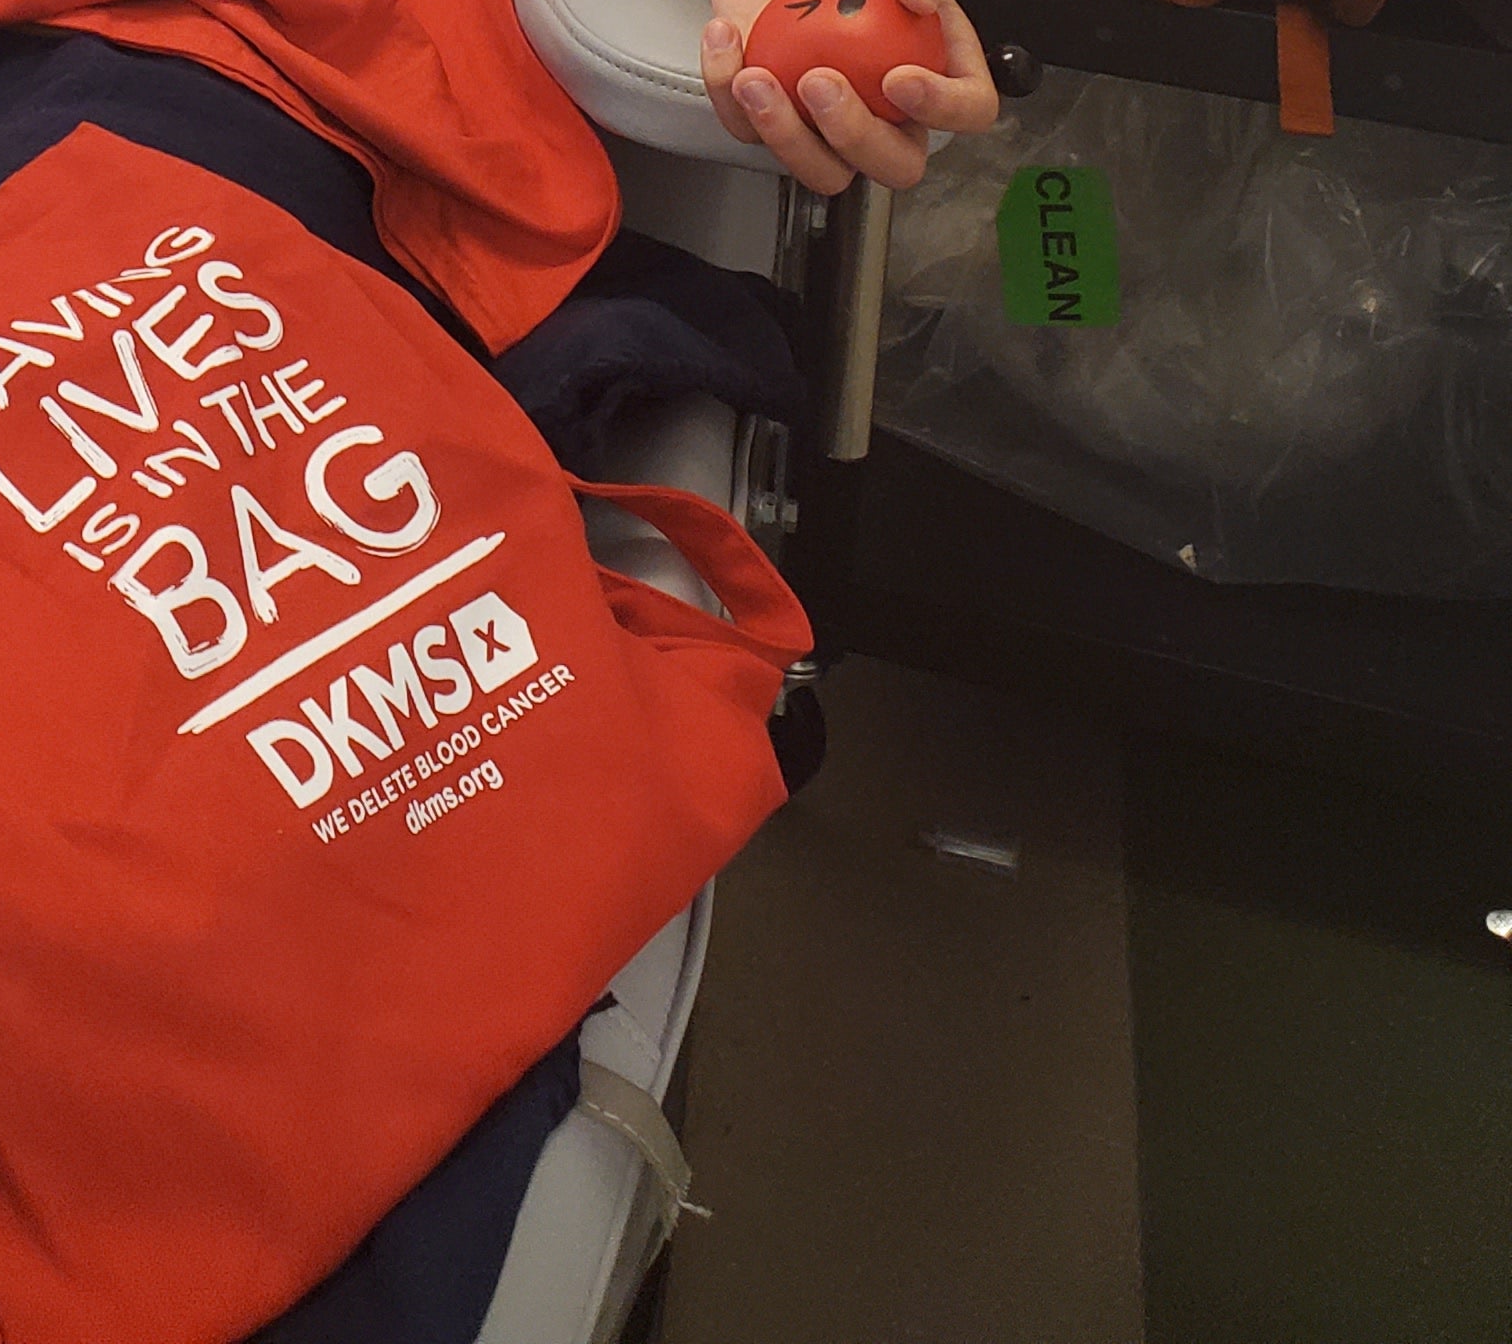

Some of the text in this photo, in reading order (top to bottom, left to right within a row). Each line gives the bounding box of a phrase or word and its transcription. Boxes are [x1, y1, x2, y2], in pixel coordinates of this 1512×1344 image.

[1033, 170, 1083, 322] CLEAN
[62, 358, 347, 573] IS IN THE
[108, 424, 442, 679] BAG
[246, 624, 474, 810] DKMS
[311, 664, 576, 844] WE DELETE BLOOD CANCER
[405, 759, 504, 835] dkms.org
